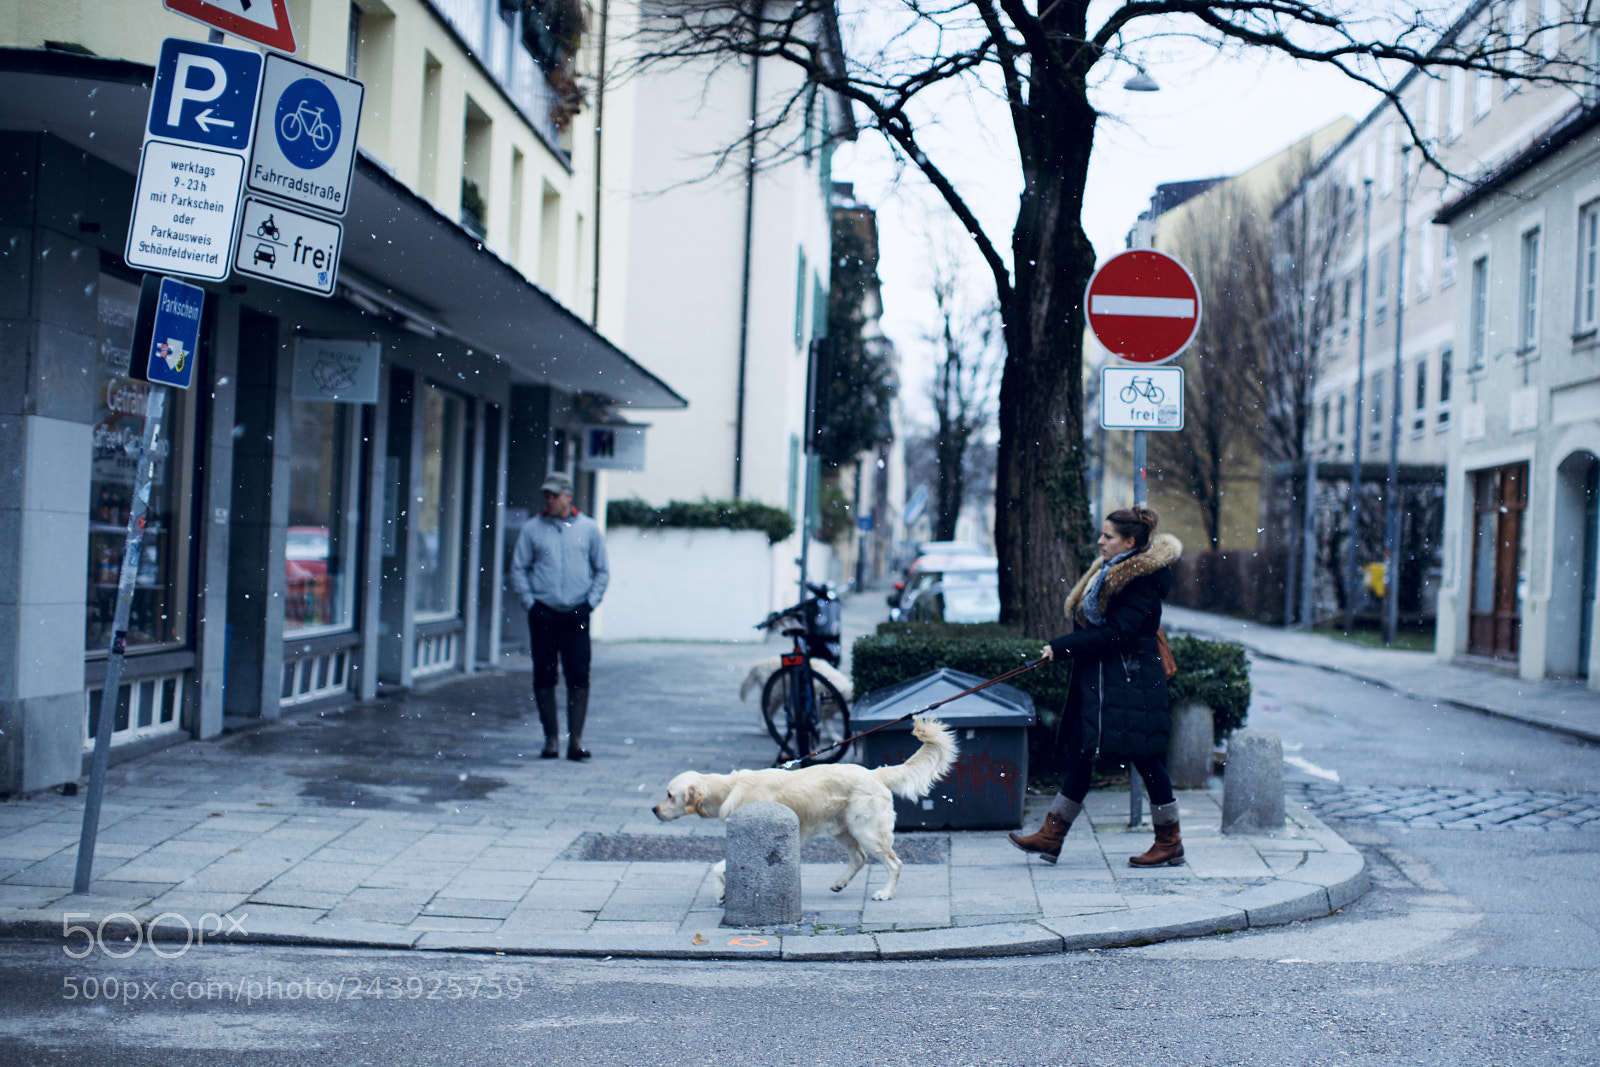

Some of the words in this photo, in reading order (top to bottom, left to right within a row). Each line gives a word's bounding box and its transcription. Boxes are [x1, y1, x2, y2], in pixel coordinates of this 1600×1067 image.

[166, 52, 227, 127] P
[170, 160, 216, 179] werktags
[254, 164, 341, 202] Fahrradstraße
[150, 191, 167, 203] mit
[171, 193, 224, 213] Parkschein
[173, 212, 195, 226] oder
[150, 225, 212, 246] Parkausweis
[138, 240, 219, 265] Schönfeldviertel
[293, 235, 333, 271] frei
[161, 292, 199, 321] Parkschein
[1131, 407, 1155, 421] frei
